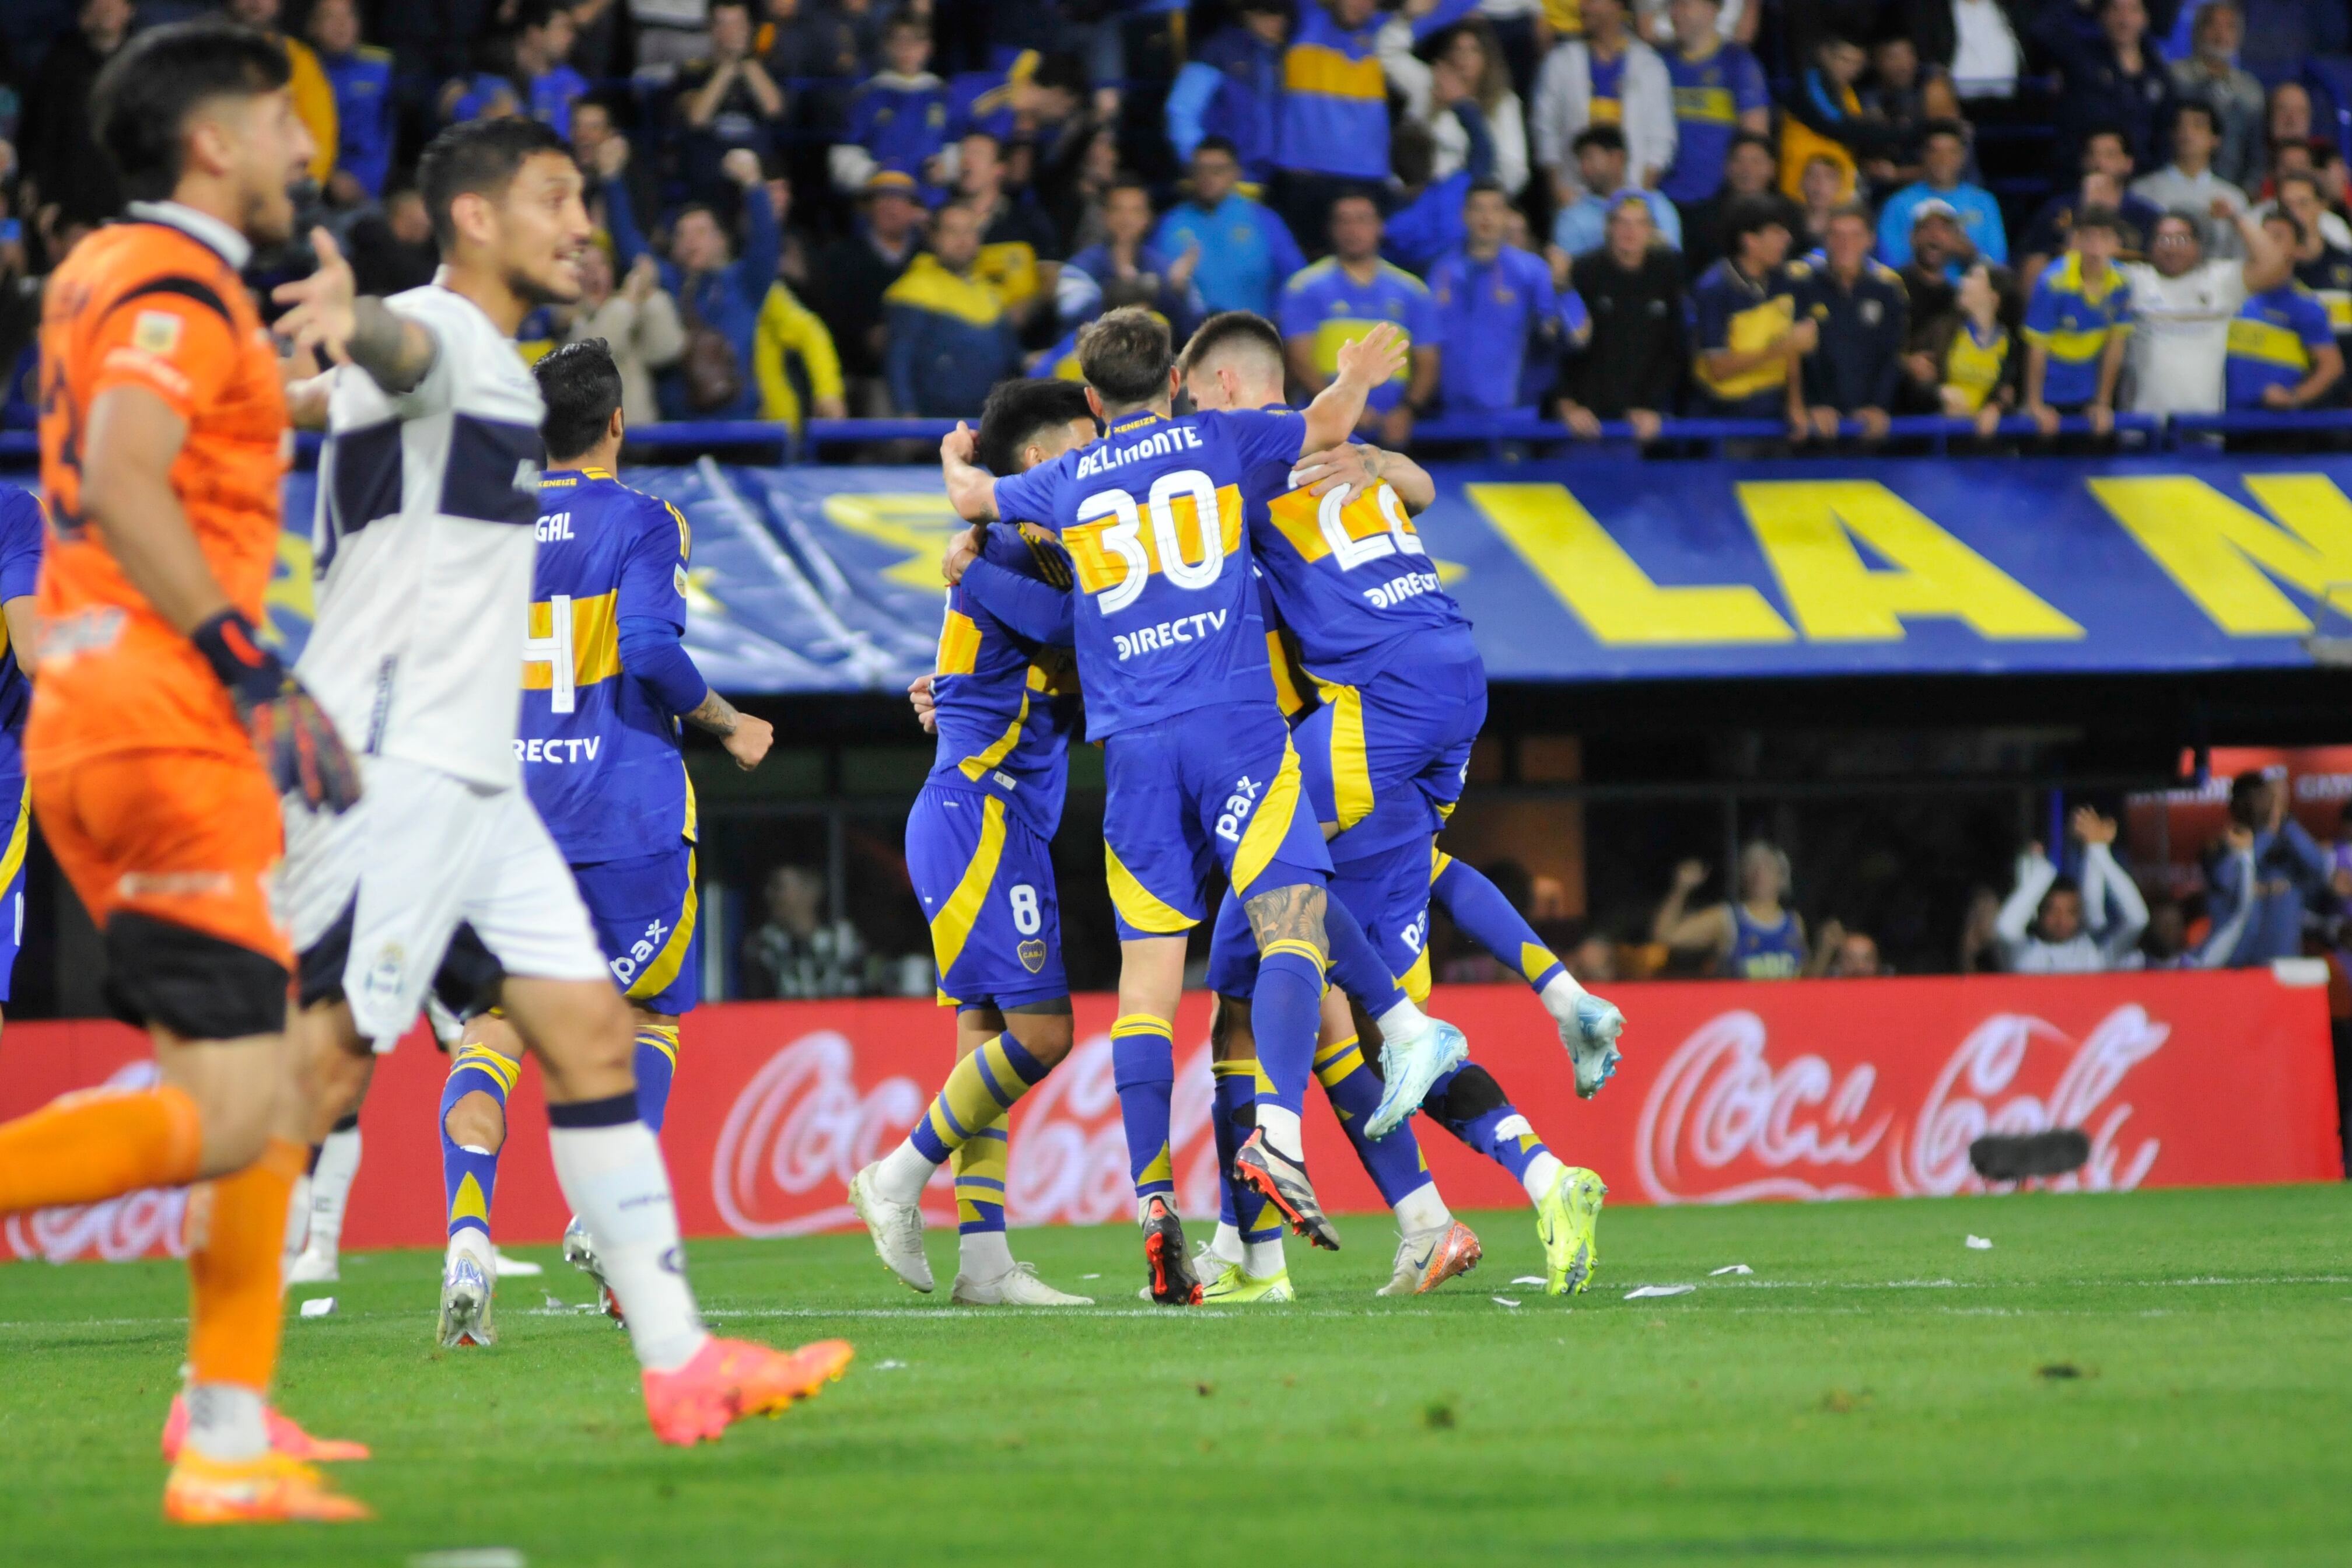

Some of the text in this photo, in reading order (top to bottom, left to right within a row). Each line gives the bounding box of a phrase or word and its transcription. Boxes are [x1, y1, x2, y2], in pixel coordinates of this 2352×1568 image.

[1113, 415, 1157, 433] XENEIZE
[534, 511, 575, 542] GAL
[1076, 469, 1225, 616] 30
[1464, 481, 2087, 644] LA
[519, 594, 575, 713] 4
[1113, 608, 1227, 661] DIRECTV
[512, 736, 600, 764] RECTV
[1215, 775, 1262, 842] pax
[1009, 884, 1041, 935] 8
[1401, 898, 1430, 955] pa
[609, 919, 668, 985] pax
